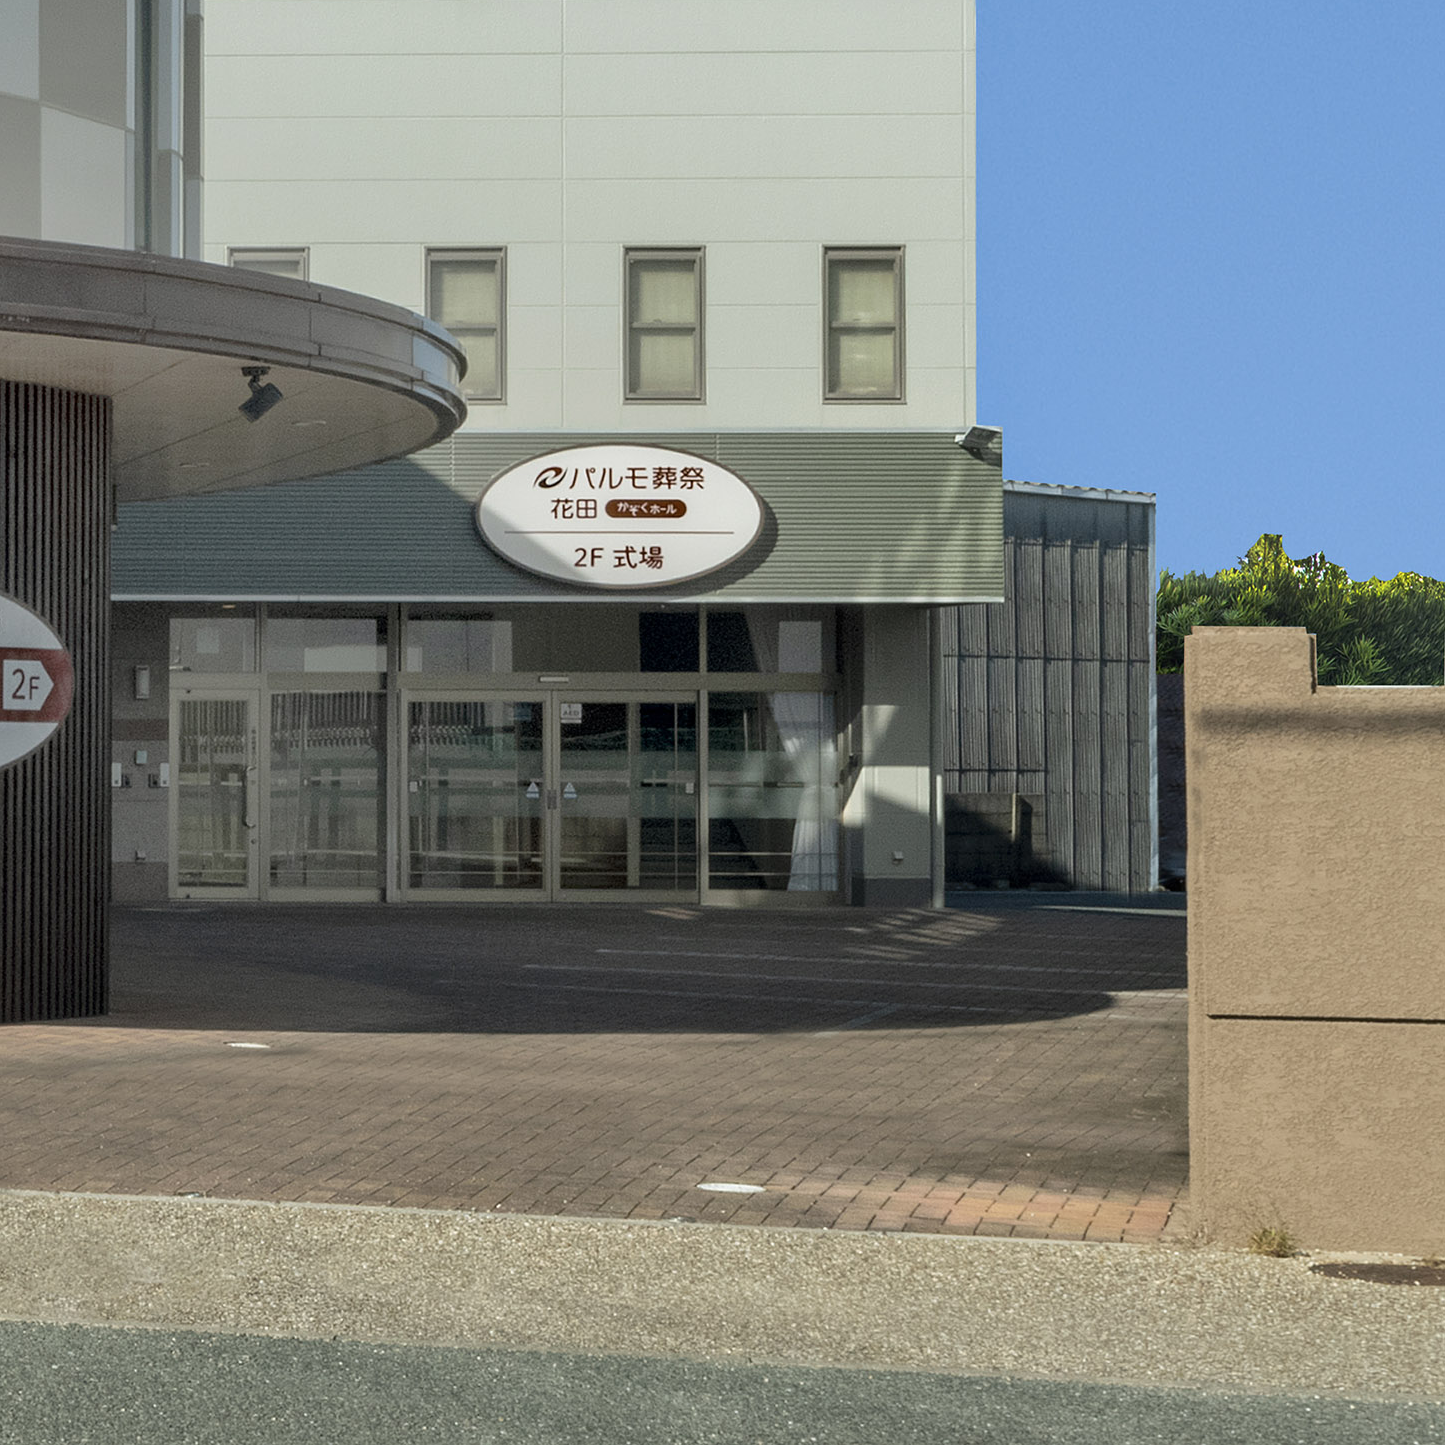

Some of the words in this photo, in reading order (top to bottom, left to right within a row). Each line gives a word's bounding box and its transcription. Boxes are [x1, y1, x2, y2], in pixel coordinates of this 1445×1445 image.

[568, 465, 705, 491] パルモ葬祭
[550, 497, 598, 520] 花田
[616, 501, 678, 517] かぞくホール
[574, 547, 604, 568] 2F
[612, 545, 665, 571] 式場
[11, 668, 41, 701] 2F
